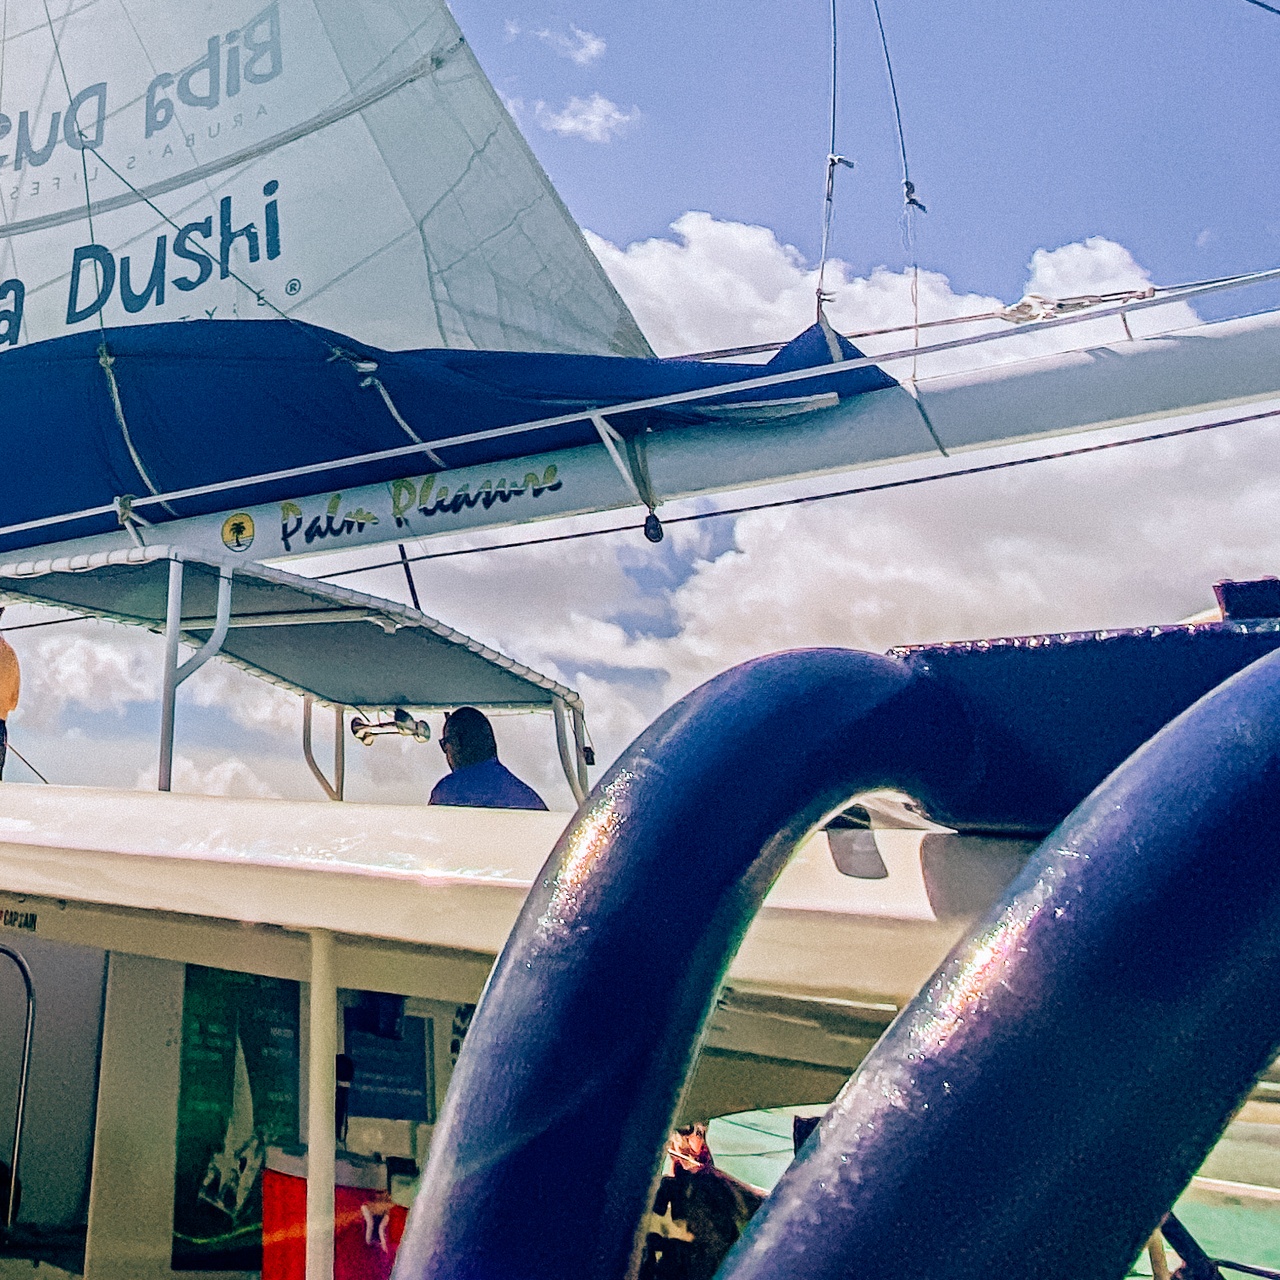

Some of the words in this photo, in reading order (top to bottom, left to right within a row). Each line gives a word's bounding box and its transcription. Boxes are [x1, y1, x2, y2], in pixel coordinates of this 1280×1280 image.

[66, 179, 280, 325] Dushi
[280, 492, 379, 552] Palm
[391, 463, 562, 528] Pleasure
